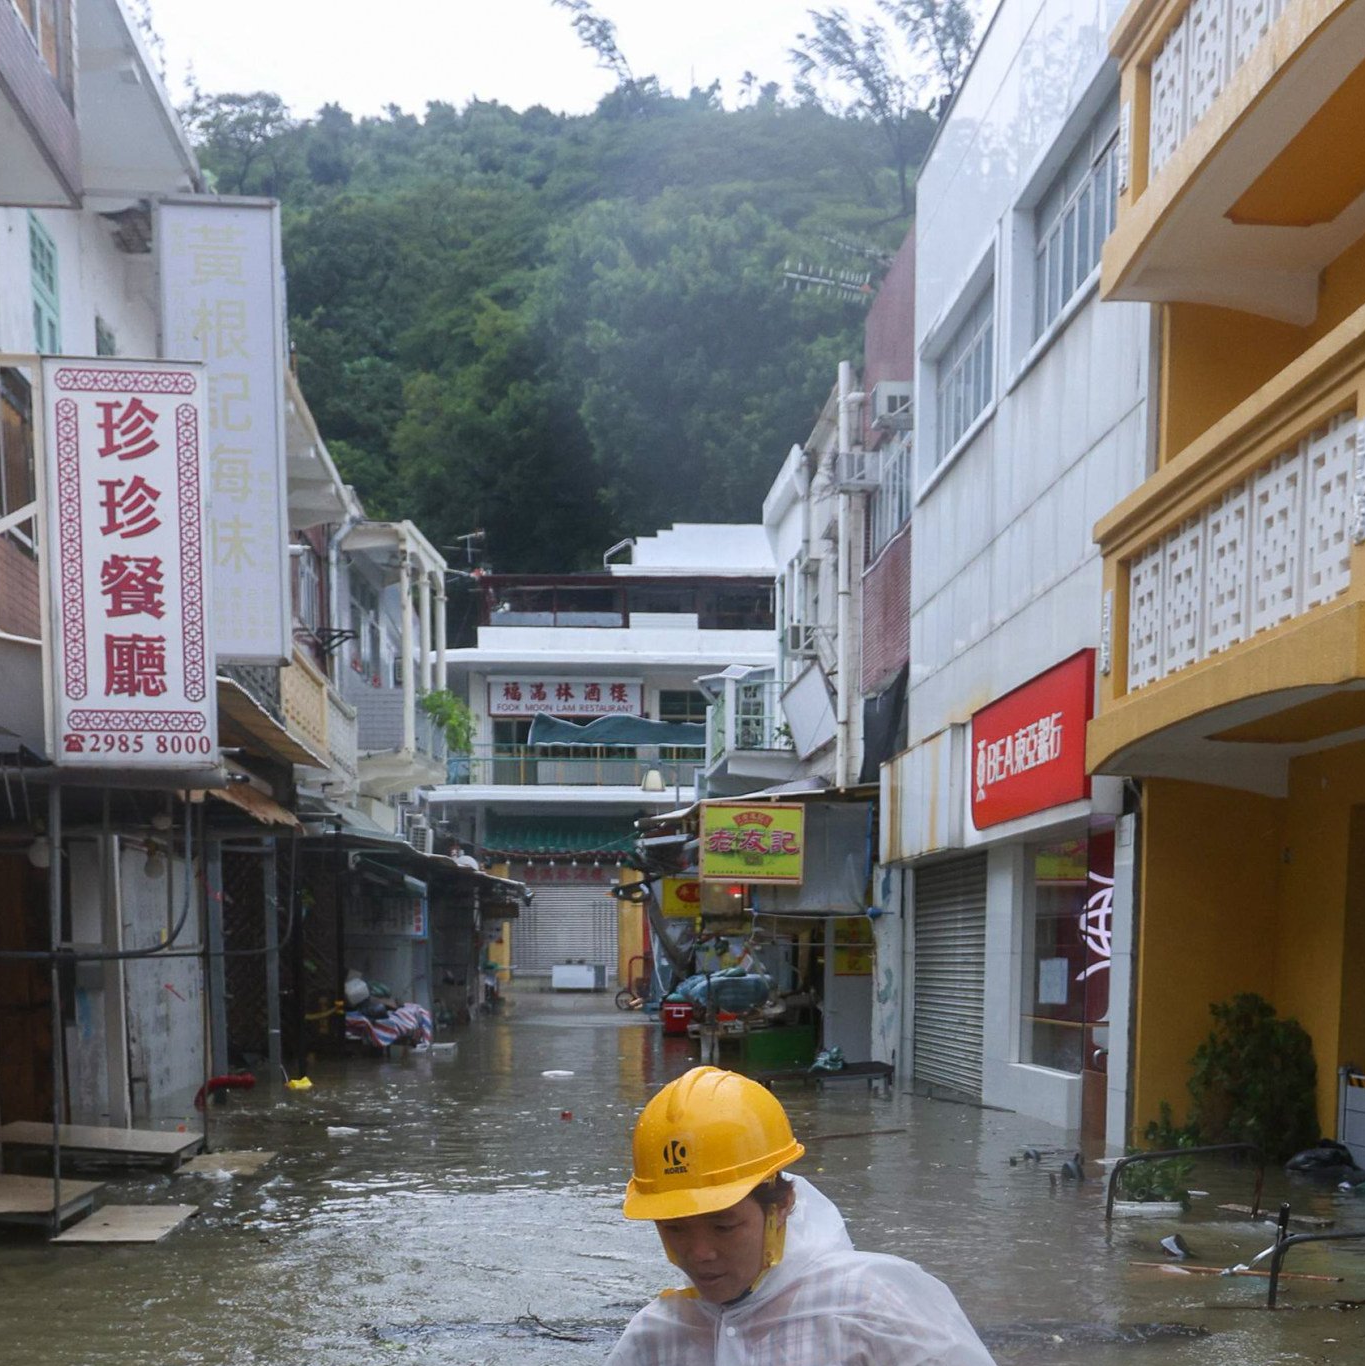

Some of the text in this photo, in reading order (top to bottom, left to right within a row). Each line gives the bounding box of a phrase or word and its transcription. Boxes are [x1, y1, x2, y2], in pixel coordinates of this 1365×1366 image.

[96, 397, 169, 699] 珍珍餐廳
[496, 703, 634, 713] FOOK MOON LAM RESTAURANT
[89, 733, 212, 754] 2985 8000
[987, 711, 1063, 785] BEA 東亞銀行
[708, 829, 800, 855] 老友記
